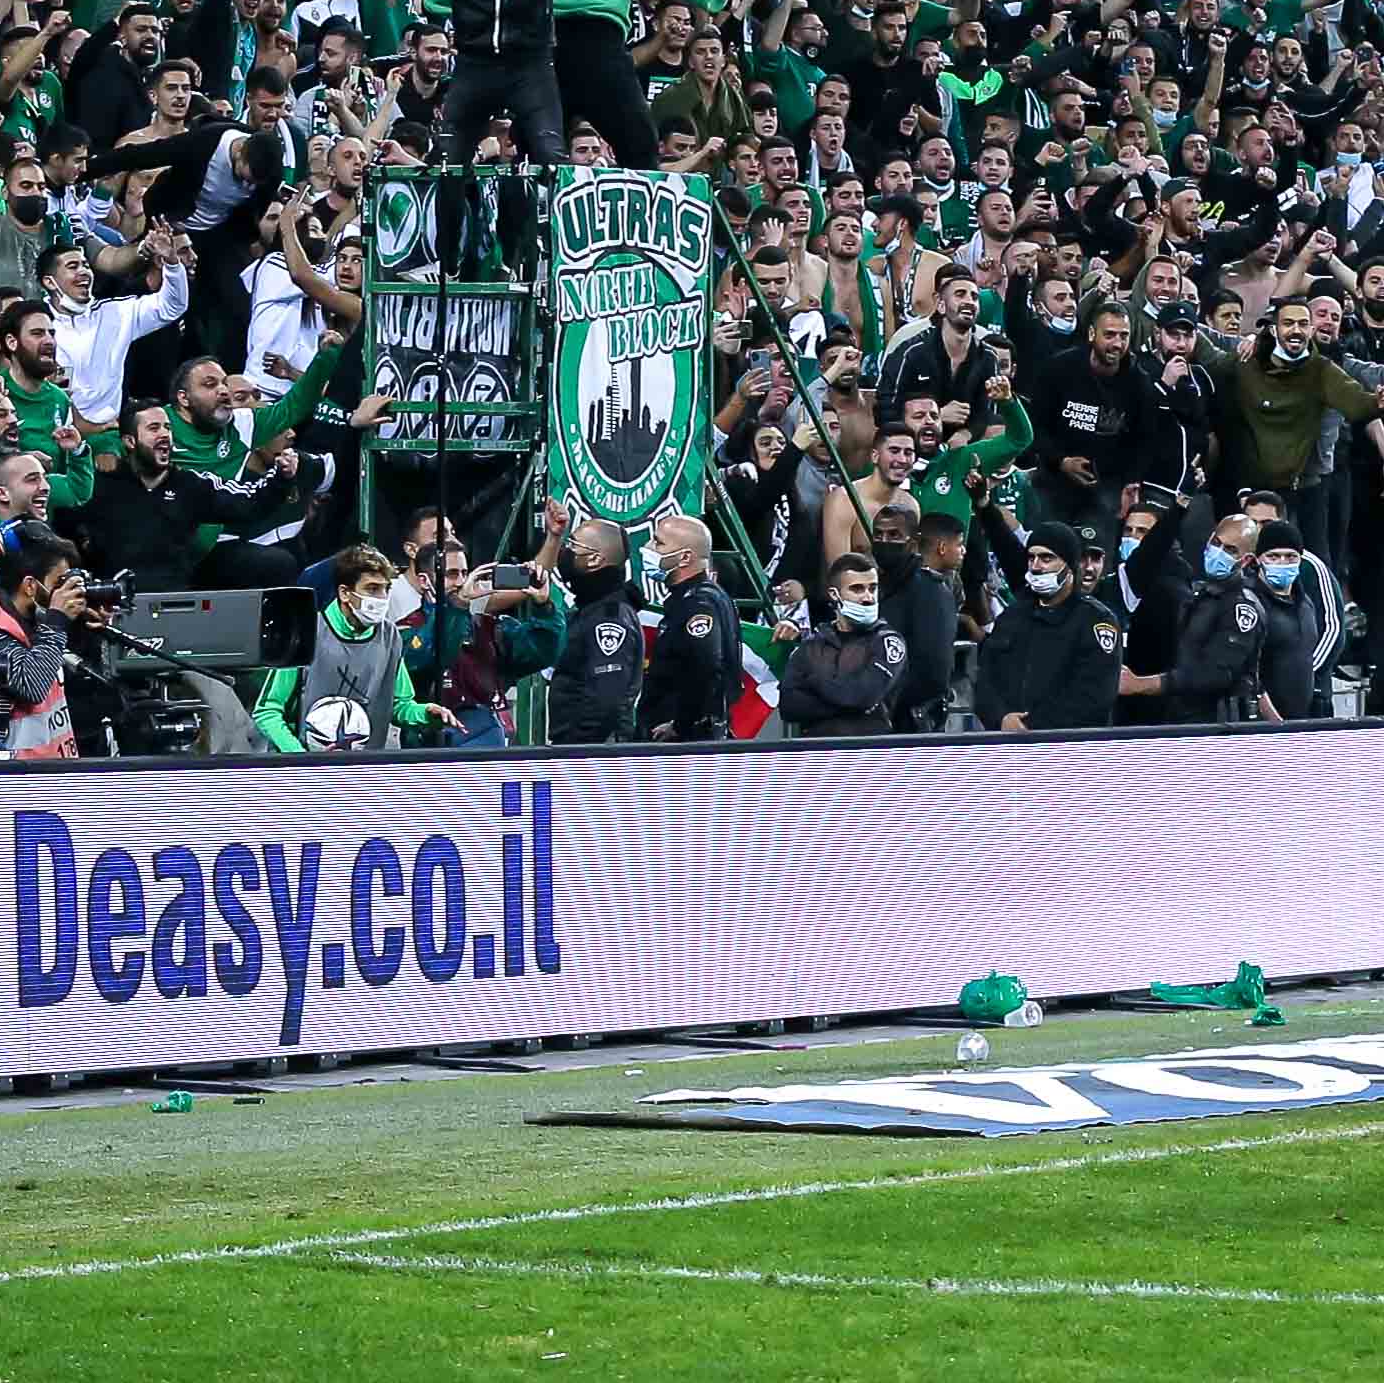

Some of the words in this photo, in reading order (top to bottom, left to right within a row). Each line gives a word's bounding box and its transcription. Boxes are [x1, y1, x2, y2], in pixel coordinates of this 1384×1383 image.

[559, 182, 708, 268] ULTRAS
[559, 263, 654, 320] NORTH
[607, 296, 703, 364] BLOCK
[1061, 408, 1098, 425] CARDIN
[1066, 401, 1099, 415] PIERRE
[1069, 418, 1096, 433] PARIS
[570, 439, 630, 512] MACCABI
[632, 442, 678, 511] HAIFA
[13, 780, 561, 1045] Deasy.co.il
